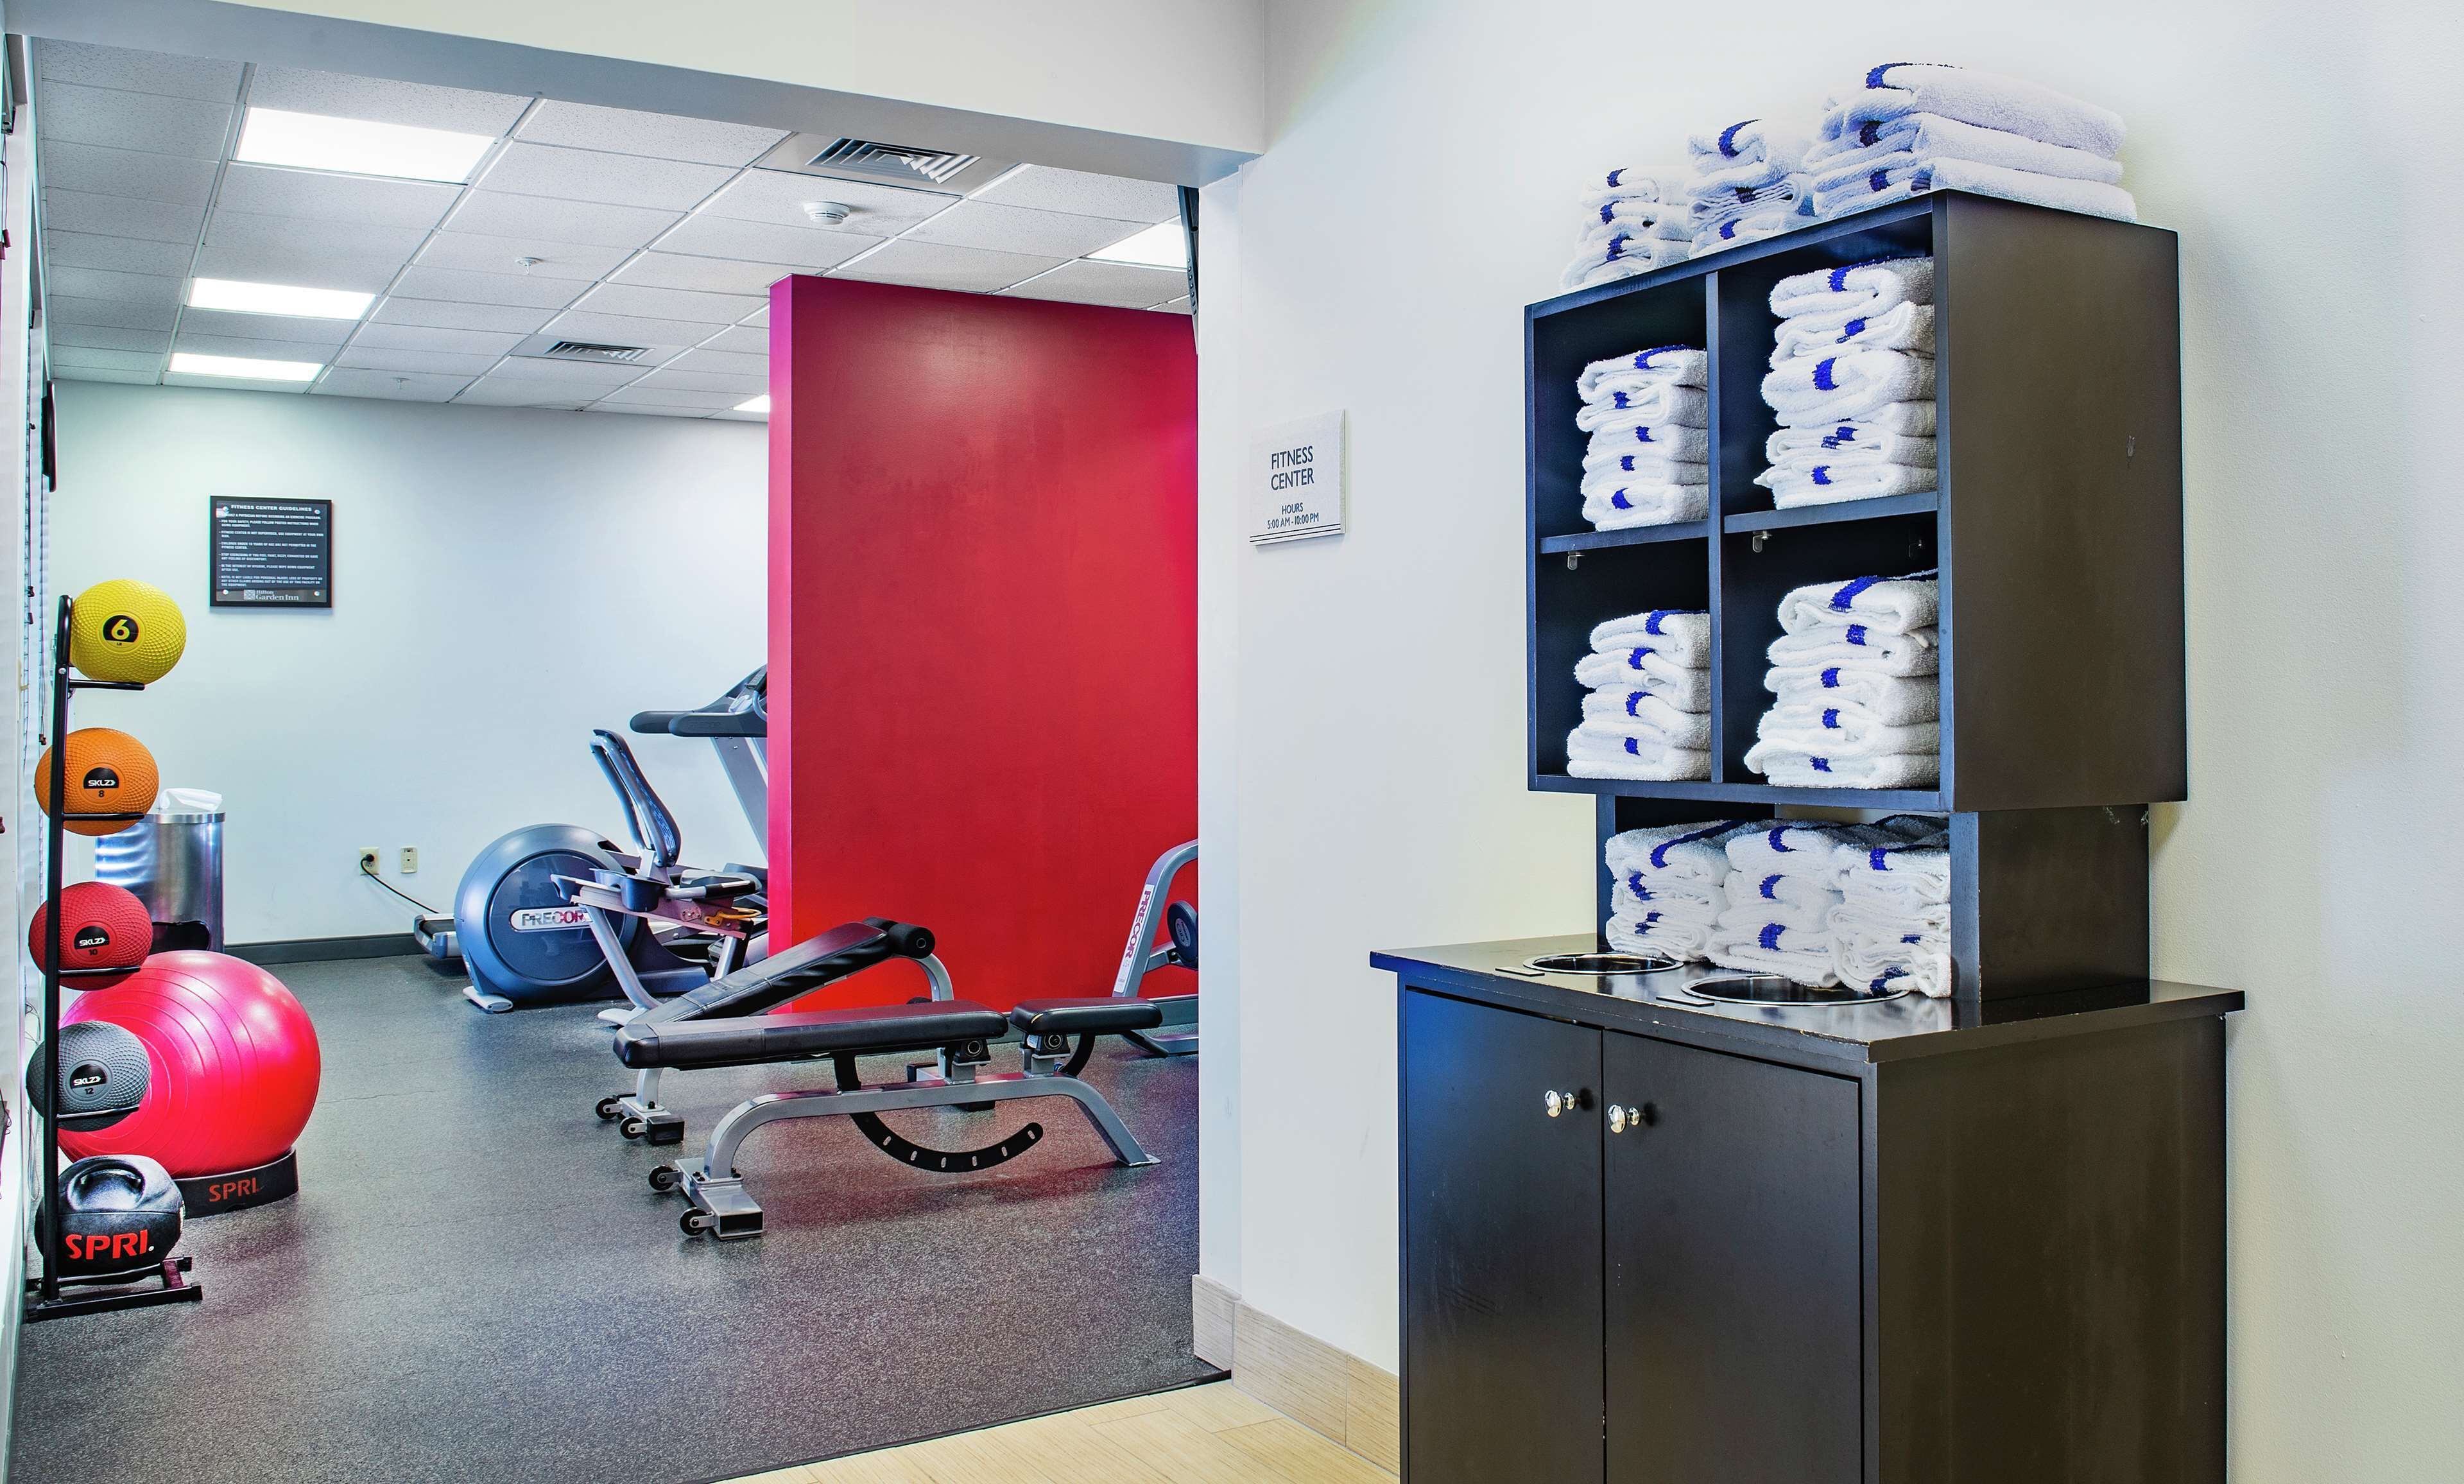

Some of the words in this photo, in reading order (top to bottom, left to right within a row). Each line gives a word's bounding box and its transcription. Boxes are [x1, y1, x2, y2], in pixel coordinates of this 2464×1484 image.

[1271, 445, 1313, 470] FITNESS
[1271, 467, 1314, 491] CENTER
[1282, 502, 1304, 515] HOURS
[1267, 518, 1279, 530] 5:00
[1280, 517, 1290, 528] AM
[1294, 513, 1309, 526] 10:00
[1310, 512, 1319, 524] PM
[111, 619, 130, 640] 6
[98, 789, 105, 798] 8
[1125, 890, 1151, 959] PRECOR
[79, 937, 106, 946] SKLZ
[73, 1076, 101, 1086] SKLZ
